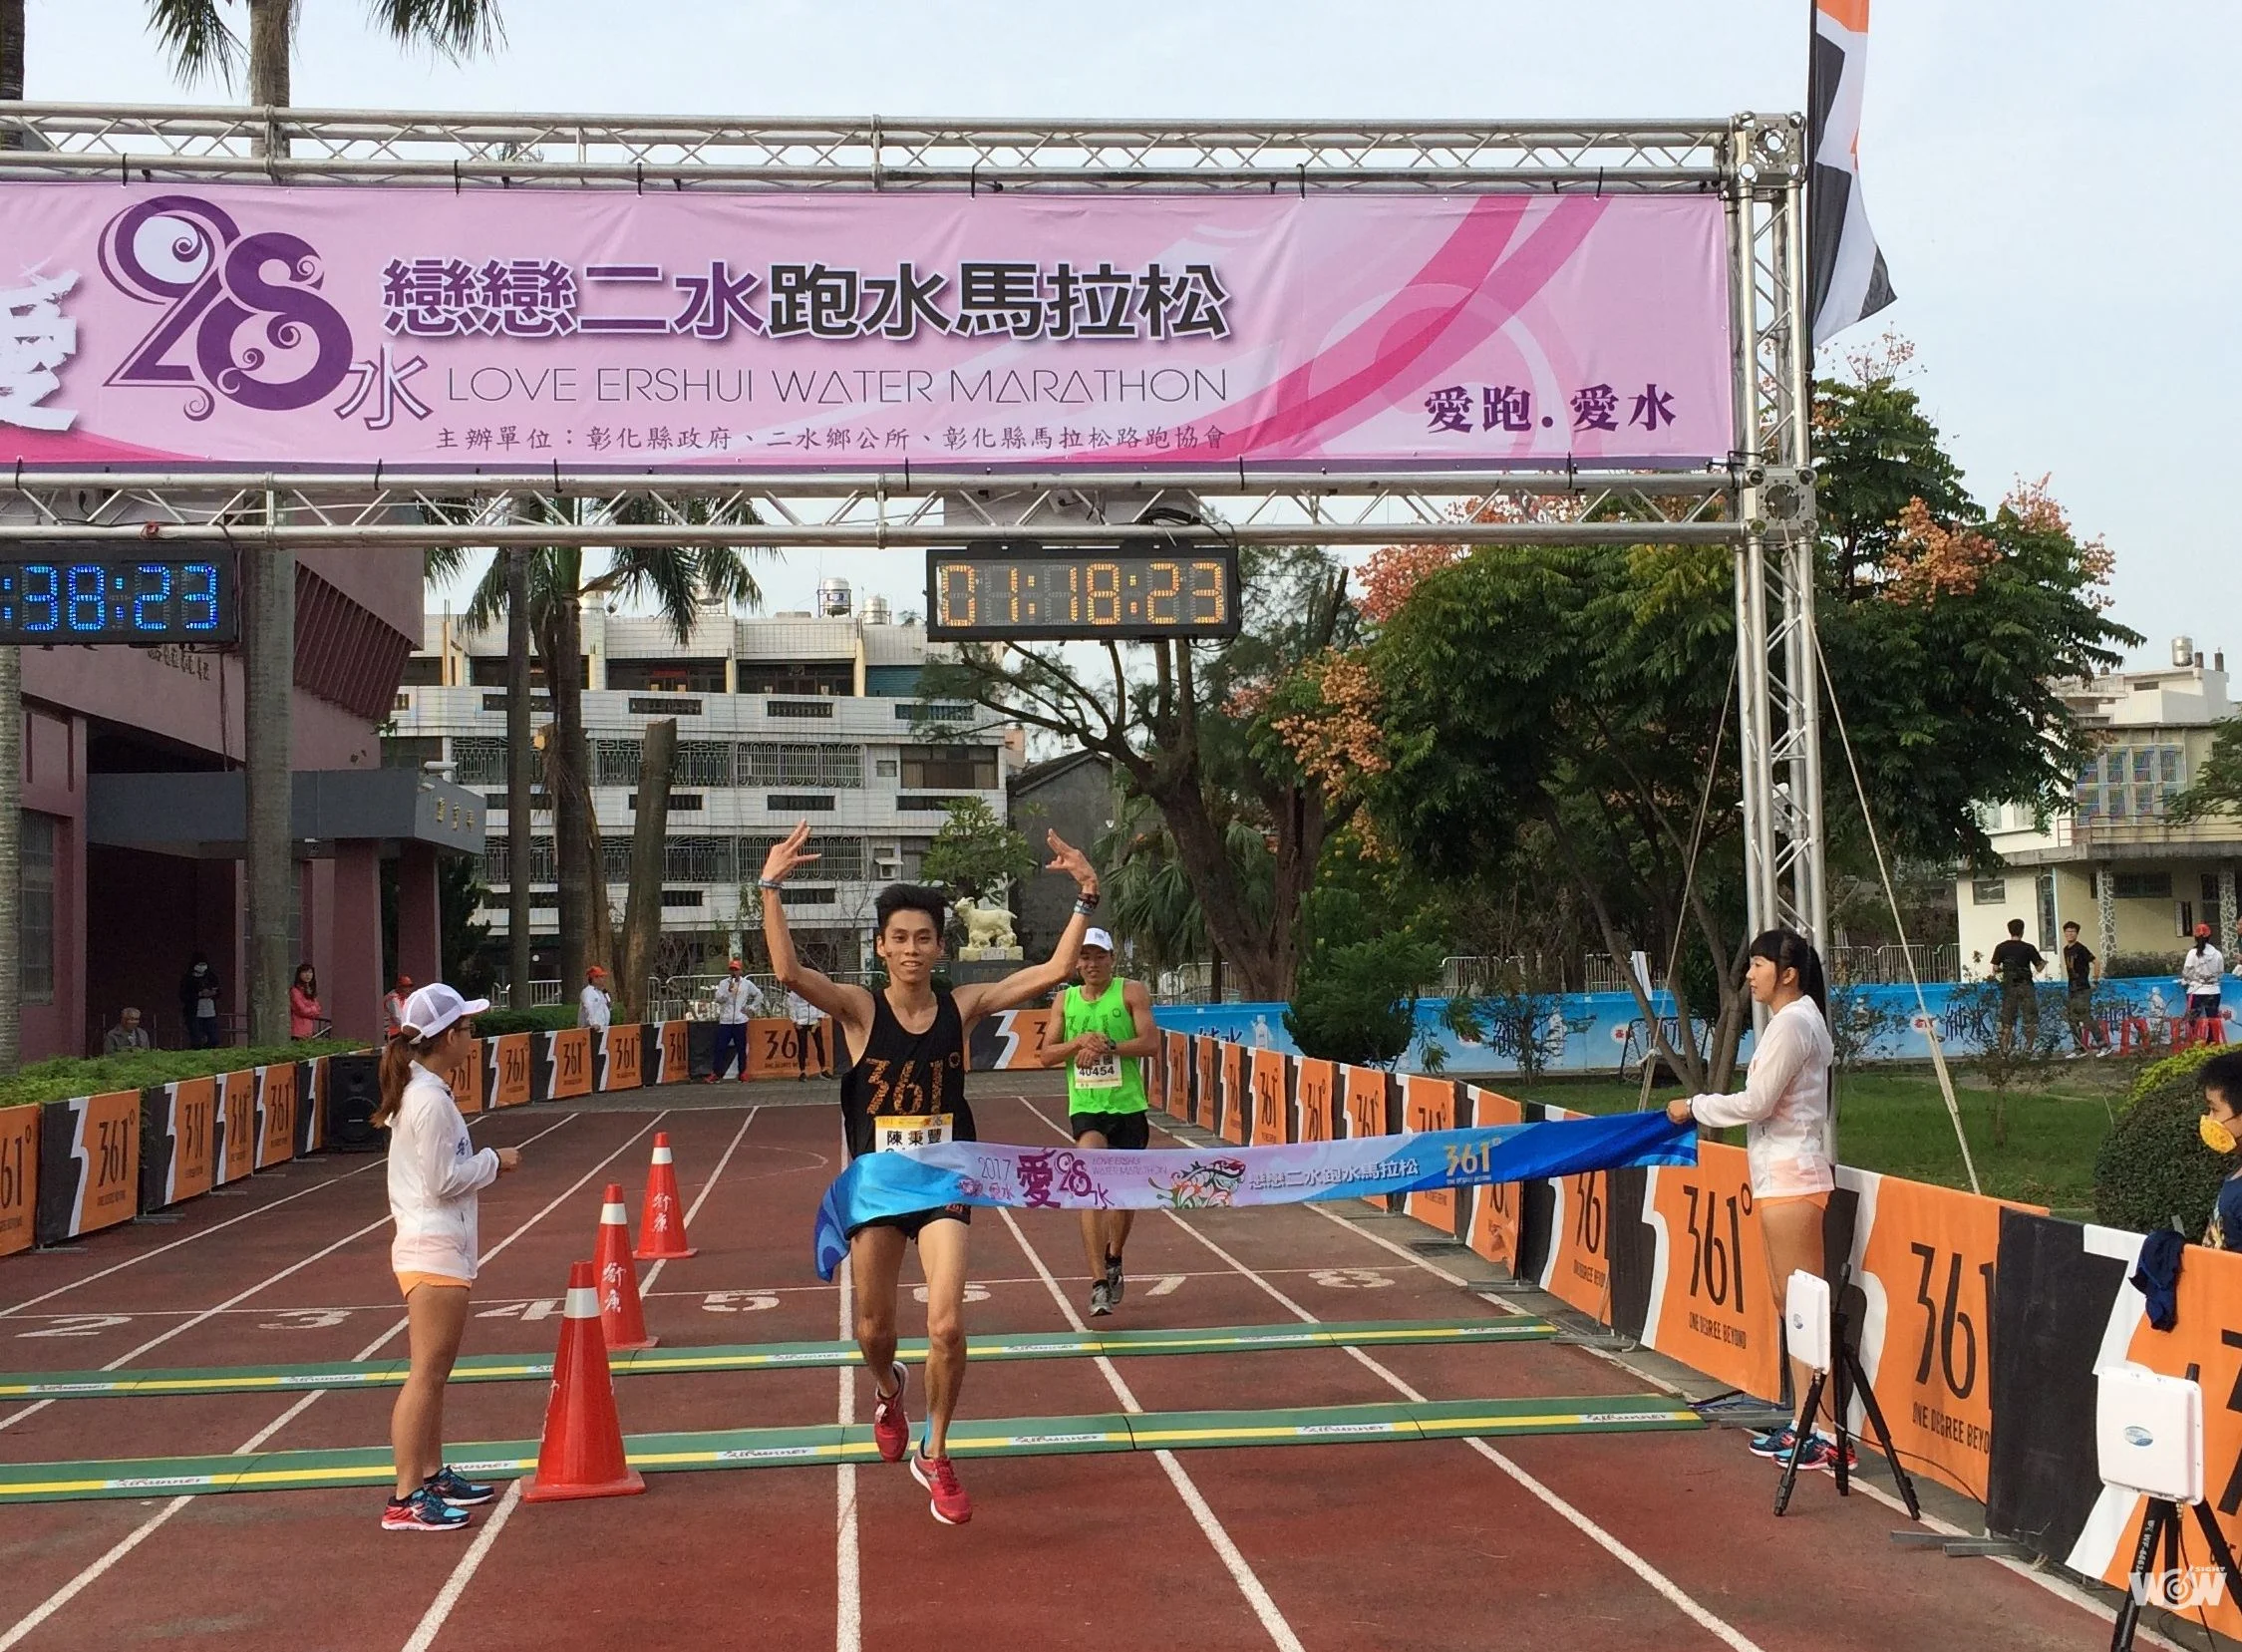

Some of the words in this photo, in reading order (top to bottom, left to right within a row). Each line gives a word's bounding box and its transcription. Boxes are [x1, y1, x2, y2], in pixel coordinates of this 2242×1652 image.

[382, 257, 1229, 340] 戀戀二水跑水馬拉松
[449, 367, 576, 401] LOVE
[597, 367, 752, 402] ERSHUI
[772, 369, 933, 403] WATER
[951, 368, 1227, 403] MARATHON
[940, 561, 1224, 627] 01:18:23
[1079, 1066, 1115, 1077] 40454
[97, 1109, 136, 1187] 361°
[977, 1156, 1011, 1181] 2017
[1683, 1182, 1753, 1314] 361°
[1306, 1269, 1396, 1289] 8
[702, 1289, 781, 1313] 5
[15, 1315, 133, 1338] 2
[258, 1309, 353, 1330] 3
[1912, 1401, 1929, 1430] ONE
[1930, 1409, 1964, 1445] DEGREE
